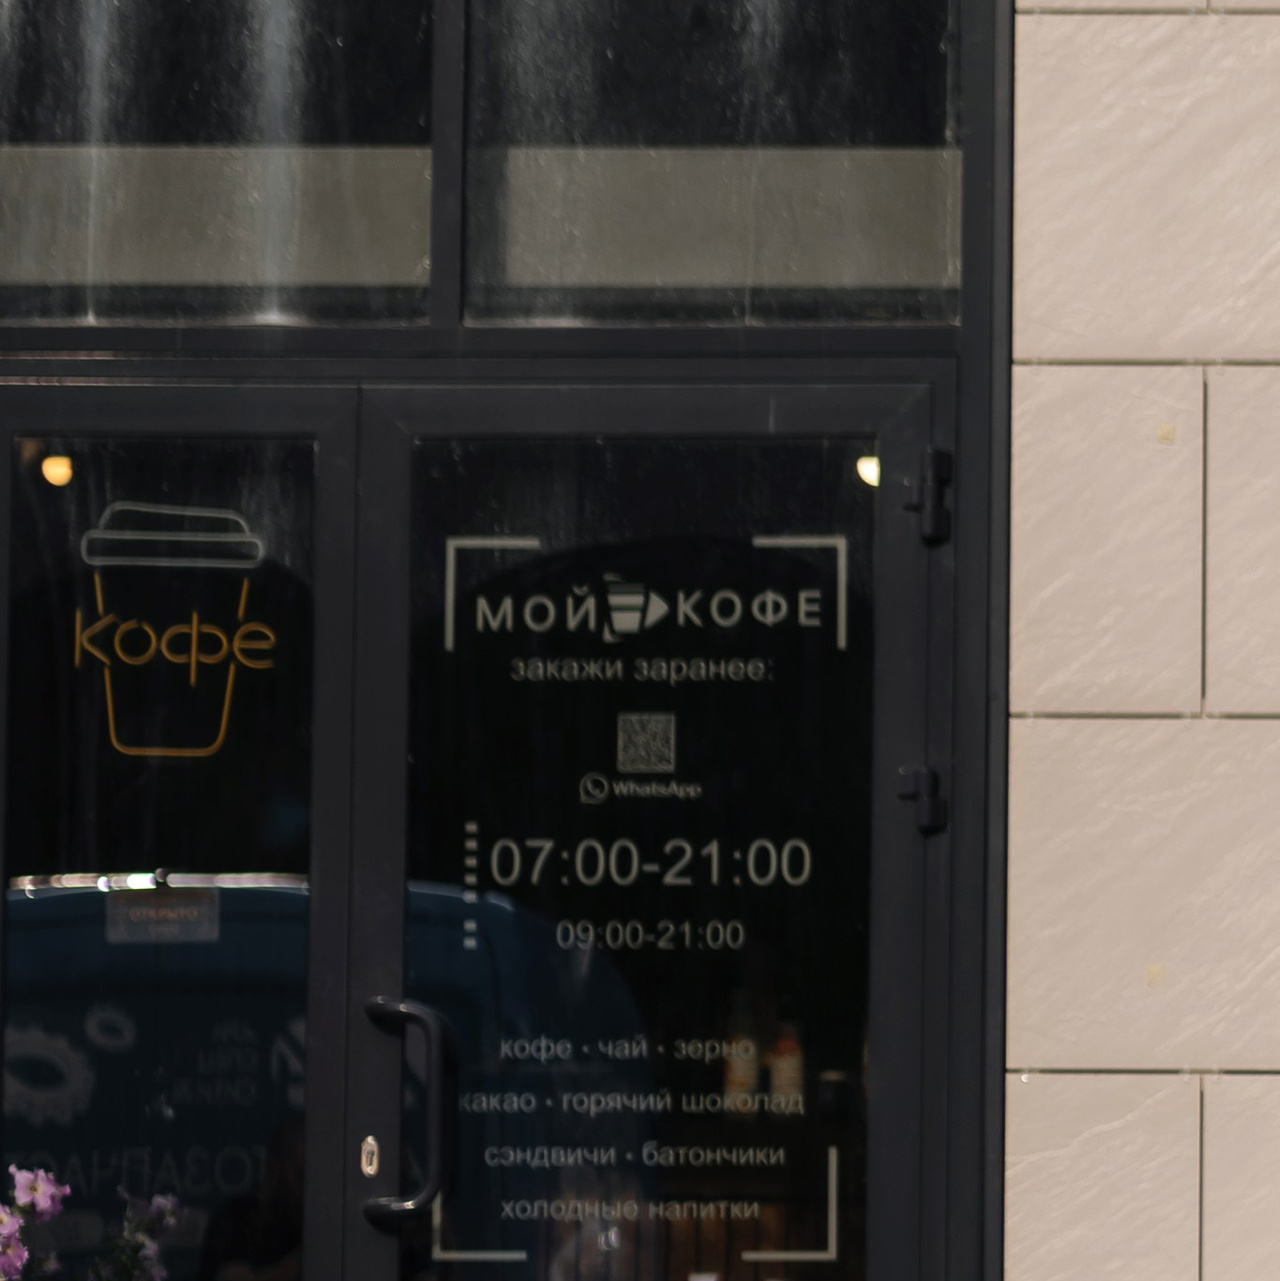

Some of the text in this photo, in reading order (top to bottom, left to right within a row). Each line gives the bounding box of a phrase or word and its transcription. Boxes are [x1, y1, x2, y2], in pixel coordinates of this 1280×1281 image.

[475, 585, 822, 633] МОЙ КОФЕ
[74, 608, 277, 688] кофе
[510, 658, 624, 682] закажи
[612, 780, 703, 800] WhatsApp
[490, 838, 812, 886] 07:00-21:00
[556, 920, 745, 950] 09:00-21:00
[500, 1034, 756, 1064] кофе чай зерно
[459, 1087, 806, 1117] какао горячий шоколад
[484, 1140, 786, 1168] сэндвичи батончики
[501, 1200, 760, 1222] холодные напитки
